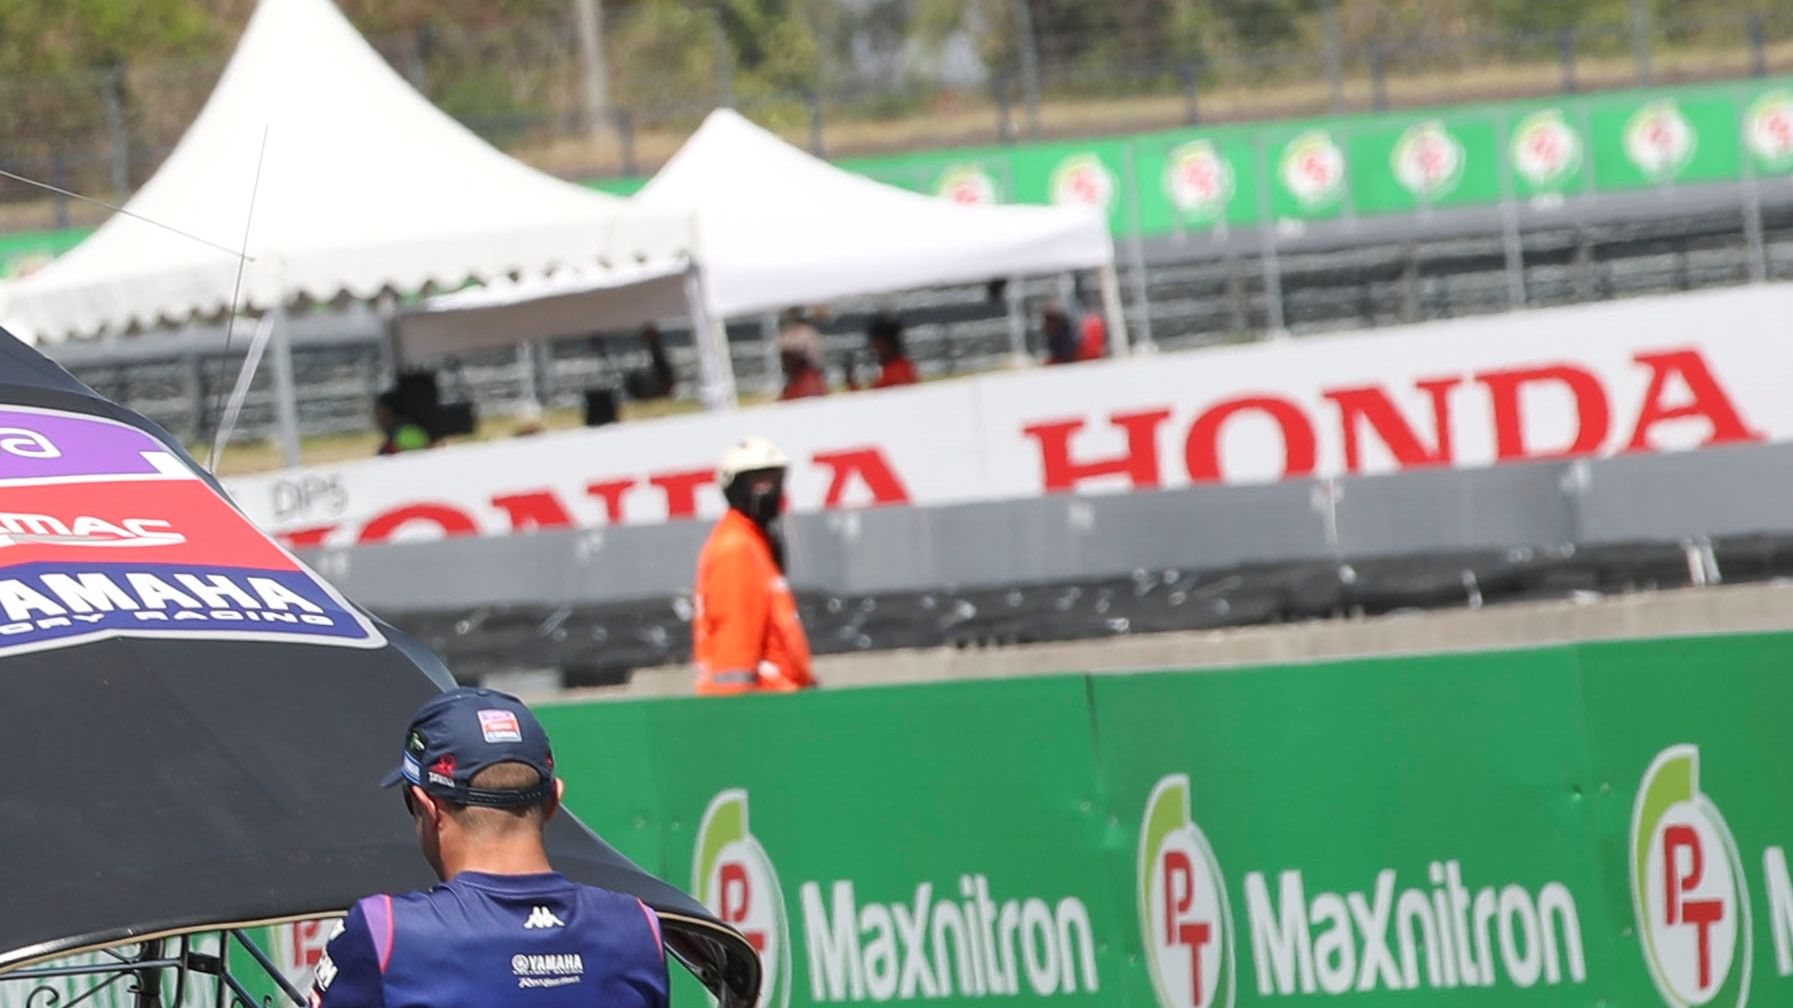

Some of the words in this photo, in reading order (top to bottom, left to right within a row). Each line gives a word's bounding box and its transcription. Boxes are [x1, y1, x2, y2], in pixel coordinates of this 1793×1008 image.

[1023, 347, 1768, 494] HONDA
[134, 609, 337, 627] RACING
[528, 953, 583, 971] YAMAHA
[799, 873, 1100, 1003] Maxnitron
[1242, 859, 1588, 997] Maxnitron
